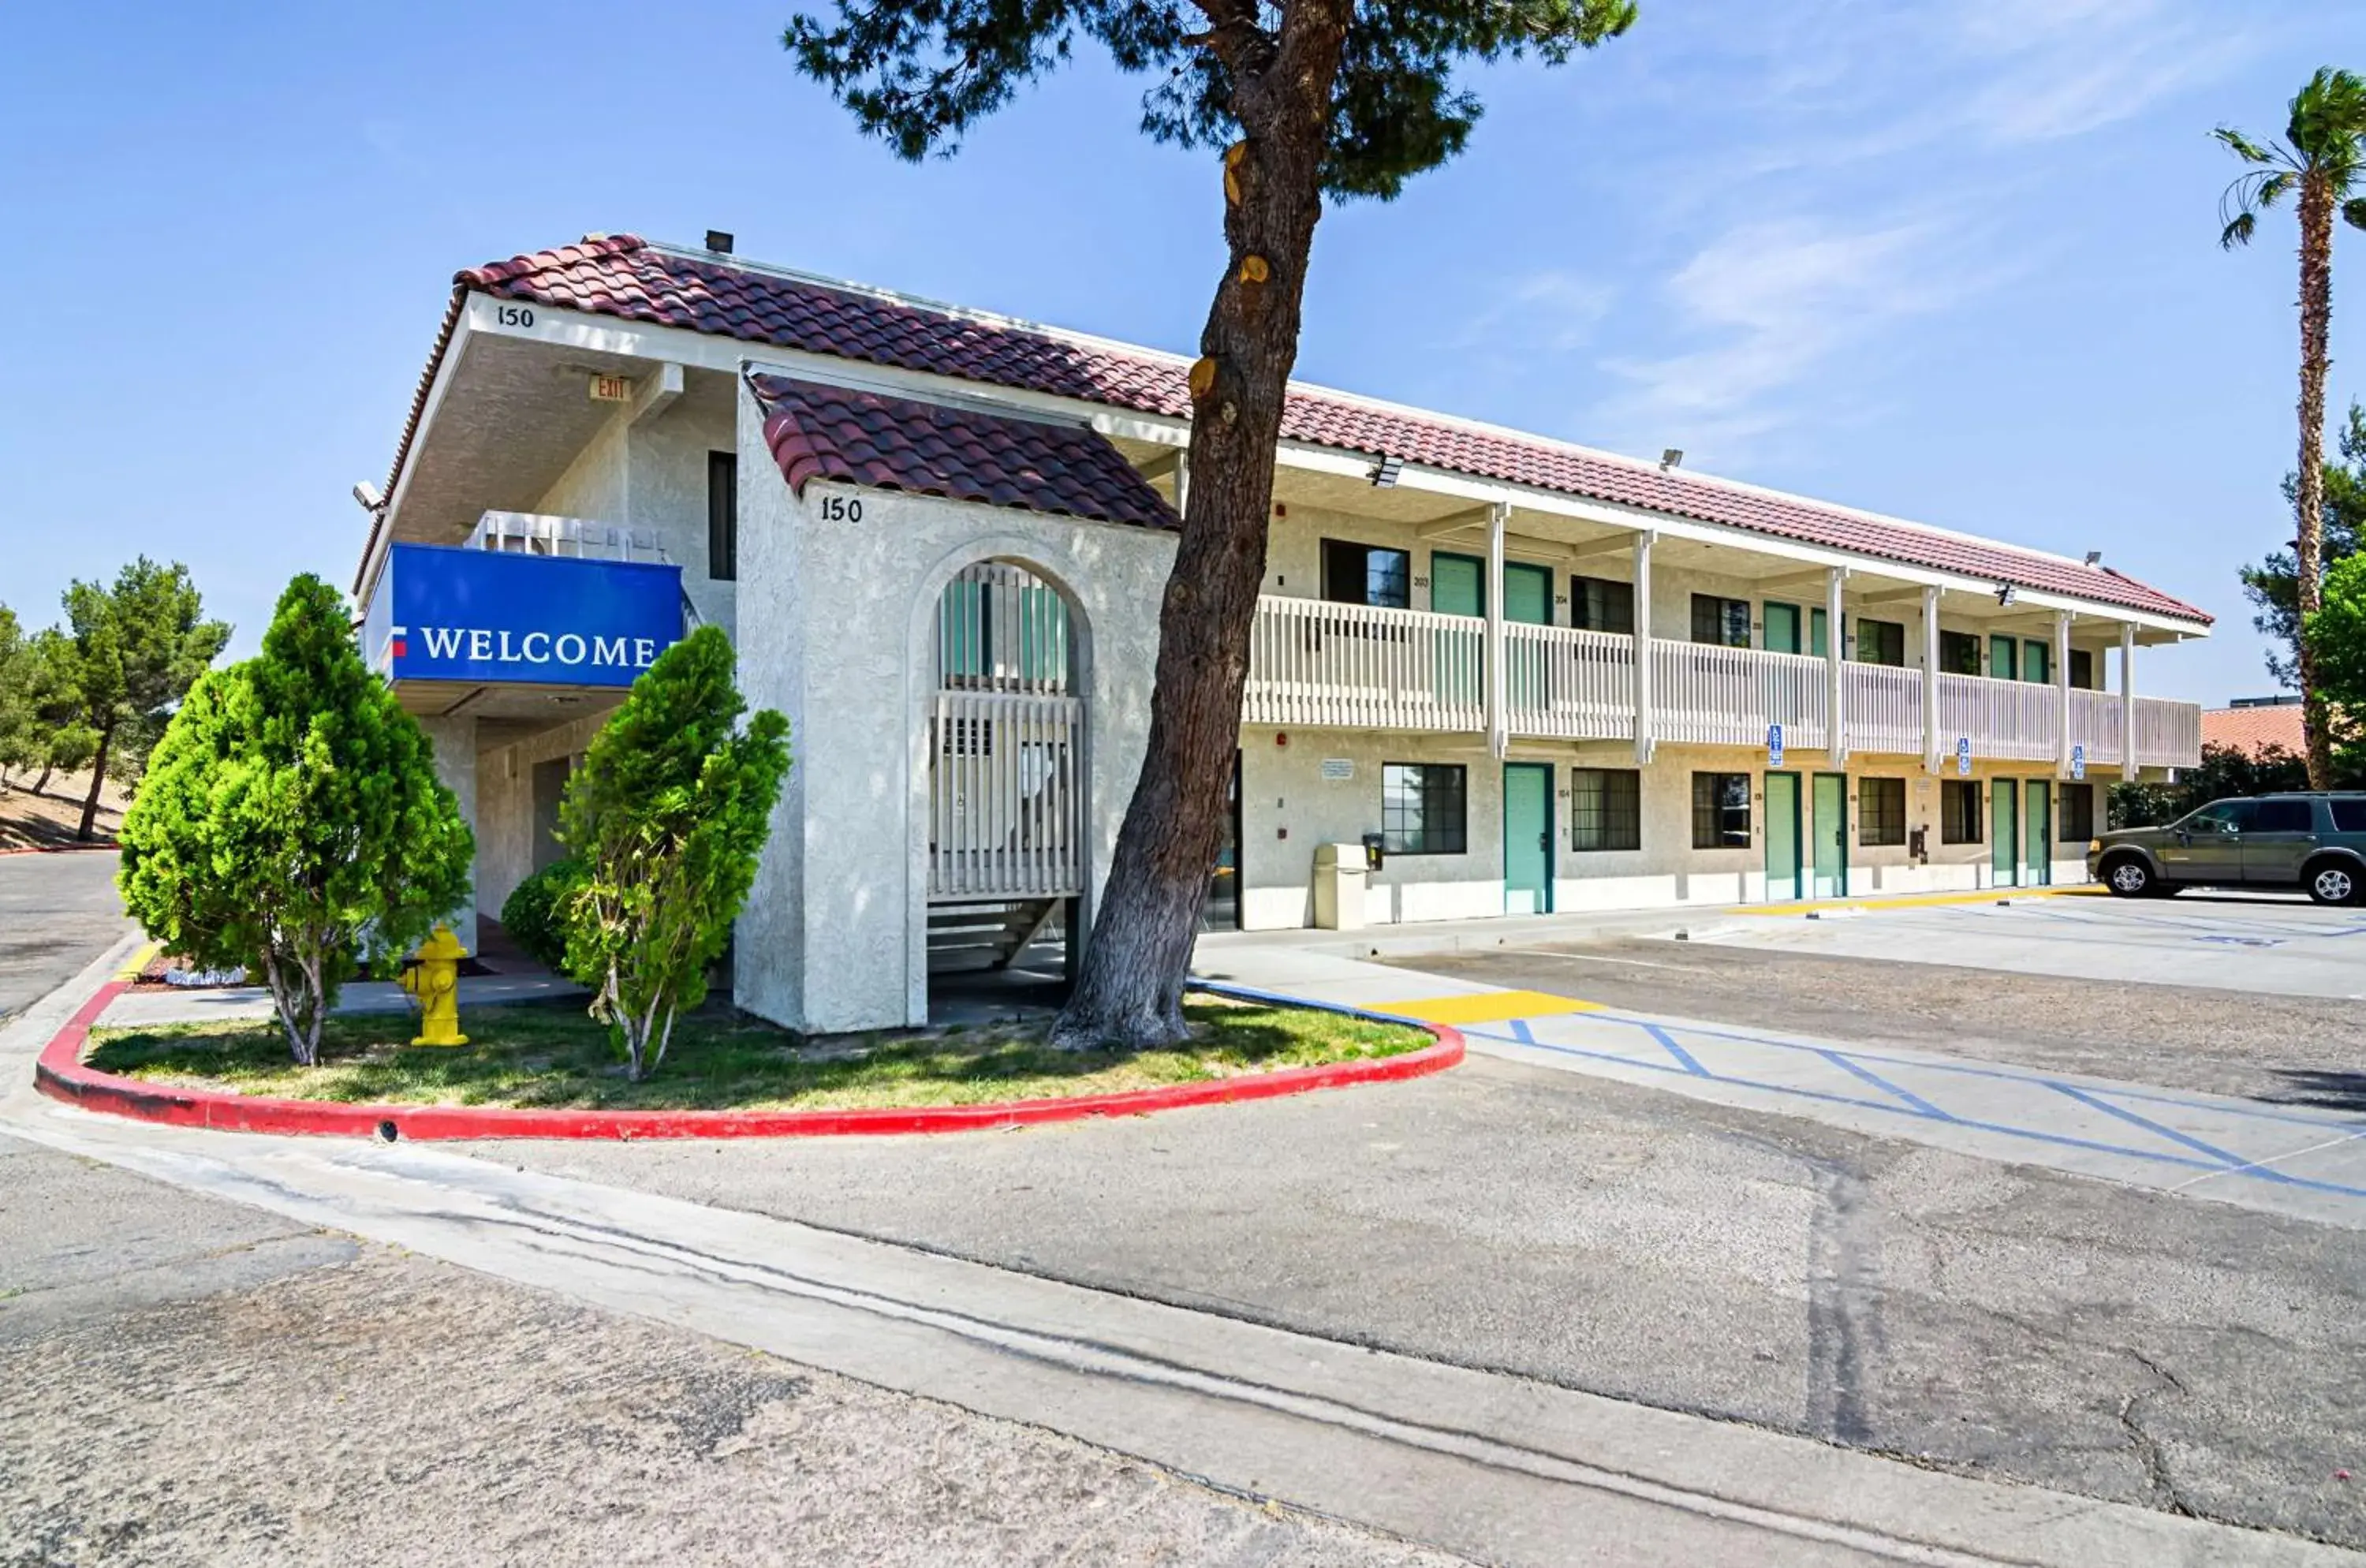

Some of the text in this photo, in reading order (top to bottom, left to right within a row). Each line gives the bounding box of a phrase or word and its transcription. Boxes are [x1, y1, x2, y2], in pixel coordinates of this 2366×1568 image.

[498, 306, 534, 328] 150
[599, 376, 624, 400] EXIT
[822, 496, 862, 523] 150
[420, 627, 656, 668] WELCOME
